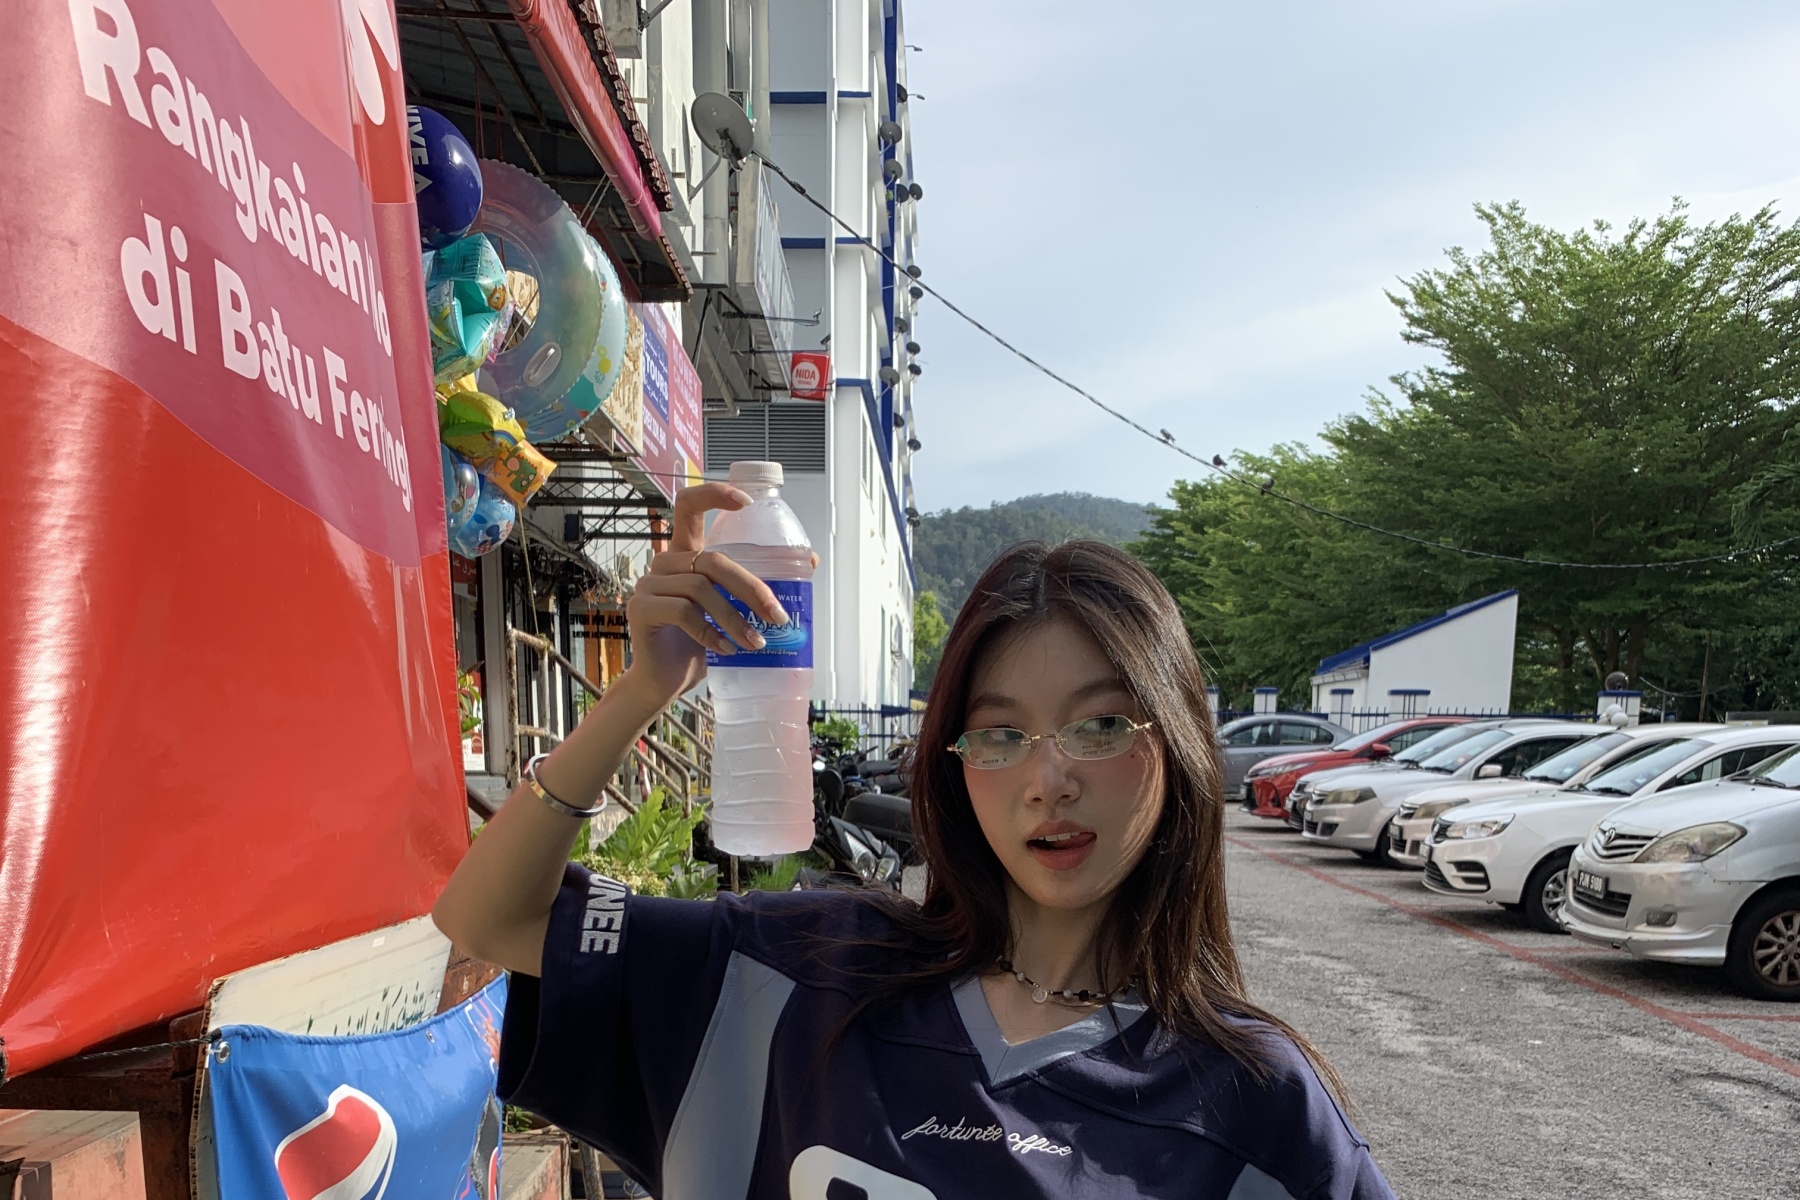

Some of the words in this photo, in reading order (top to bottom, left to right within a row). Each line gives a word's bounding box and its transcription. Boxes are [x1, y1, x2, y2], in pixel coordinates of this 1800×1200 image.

[69, 0, 370, 316] Rangkaian
[407, 104, 433, 194] NIVEA
[120, 212, 197, 355] di
[214, 259, 323, 426] Batu
[323, 345, 415, 513] Fering
[644, 357, 669, 402] TOURS
[672, 339, 699, 398] MONEY
[795, 368, 816, 381] NIDA
[778, 594, 803, 603] WATER
[1007, 1132, 1073, 1156] office
